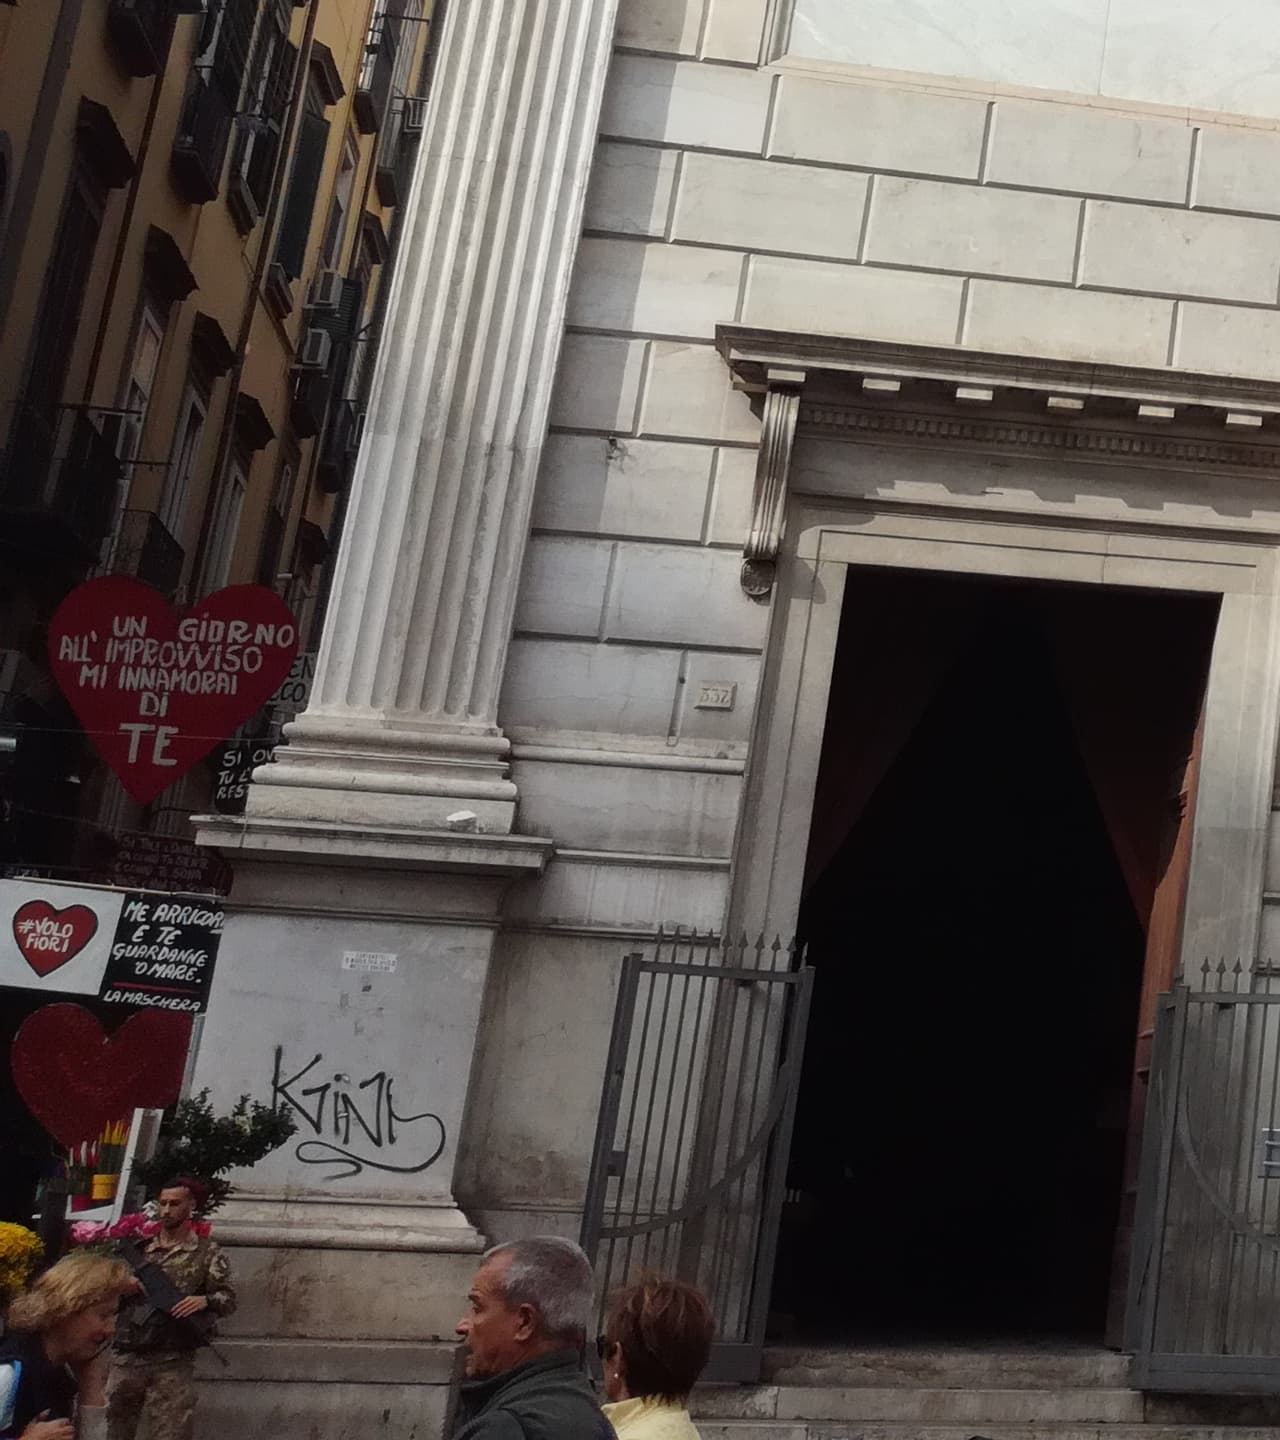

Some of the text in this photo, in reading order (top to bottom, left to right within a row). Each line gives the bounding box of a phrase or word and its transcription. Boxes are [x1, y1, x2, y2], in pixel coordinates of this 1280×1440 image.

[112, 615, 148, 638] UN
[105, 637, 263, 674] IMPROVVISO
[79, 664, 238, 696] MI INNAMORAI
[119, 722, 179, 767] TE
[123, 901, 151, 922] ME
[25, 932, 70, 953] FIORI
[131, 925, 183, 945] E TE
[112, 943, 208, 967] GUARDANNE
